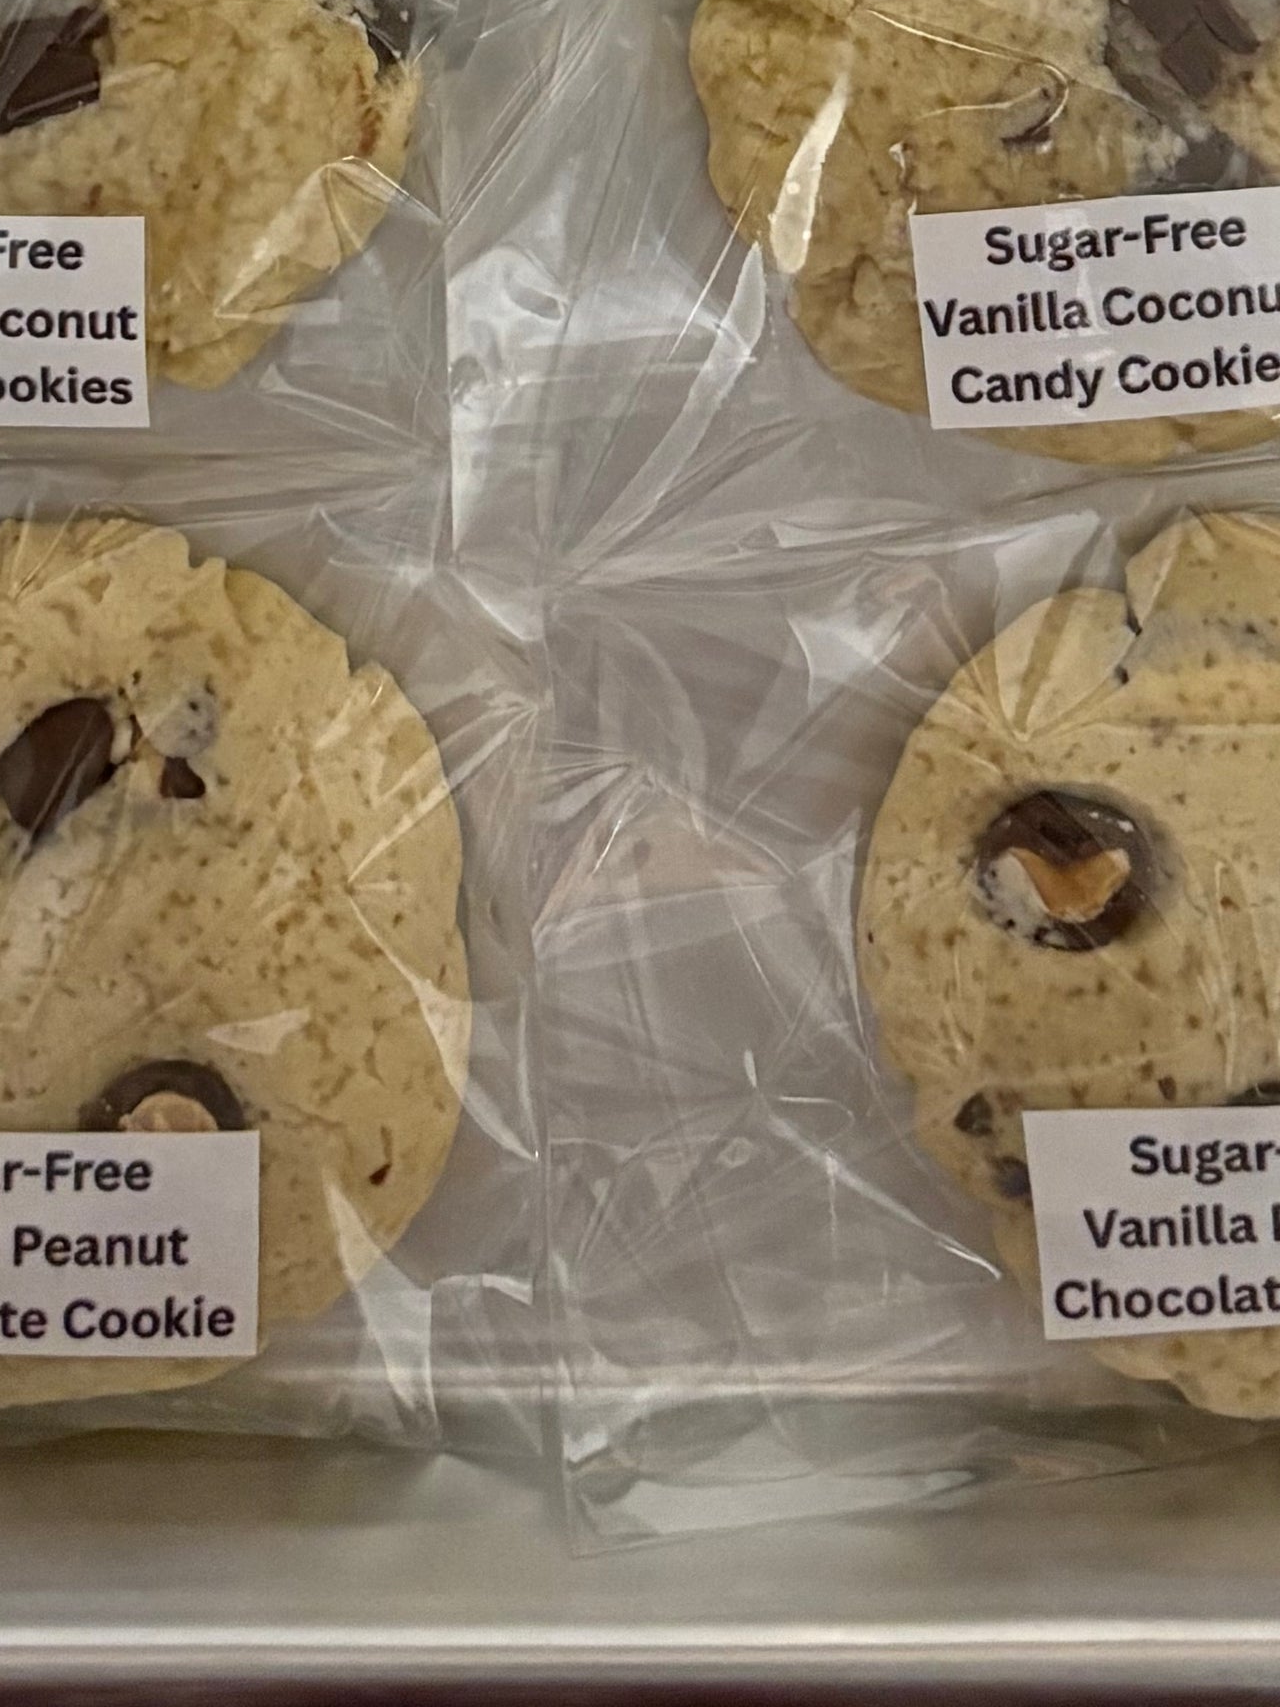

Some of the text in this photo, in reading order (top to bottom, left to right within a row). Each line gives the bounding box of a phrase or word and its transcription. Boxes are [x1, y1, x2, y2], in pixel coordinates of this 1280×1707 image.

[984, 213, 1247, 273] Sugar-Free
[923, 290, 1091, 338] Vanilla
[951, 358, 1105, 409] Candy
[12, 1225, 189, 1268] Peanut
[1082, 1203, 1259, 1250] Vanilla
[62, 1294, 236, 1340] Cookie
